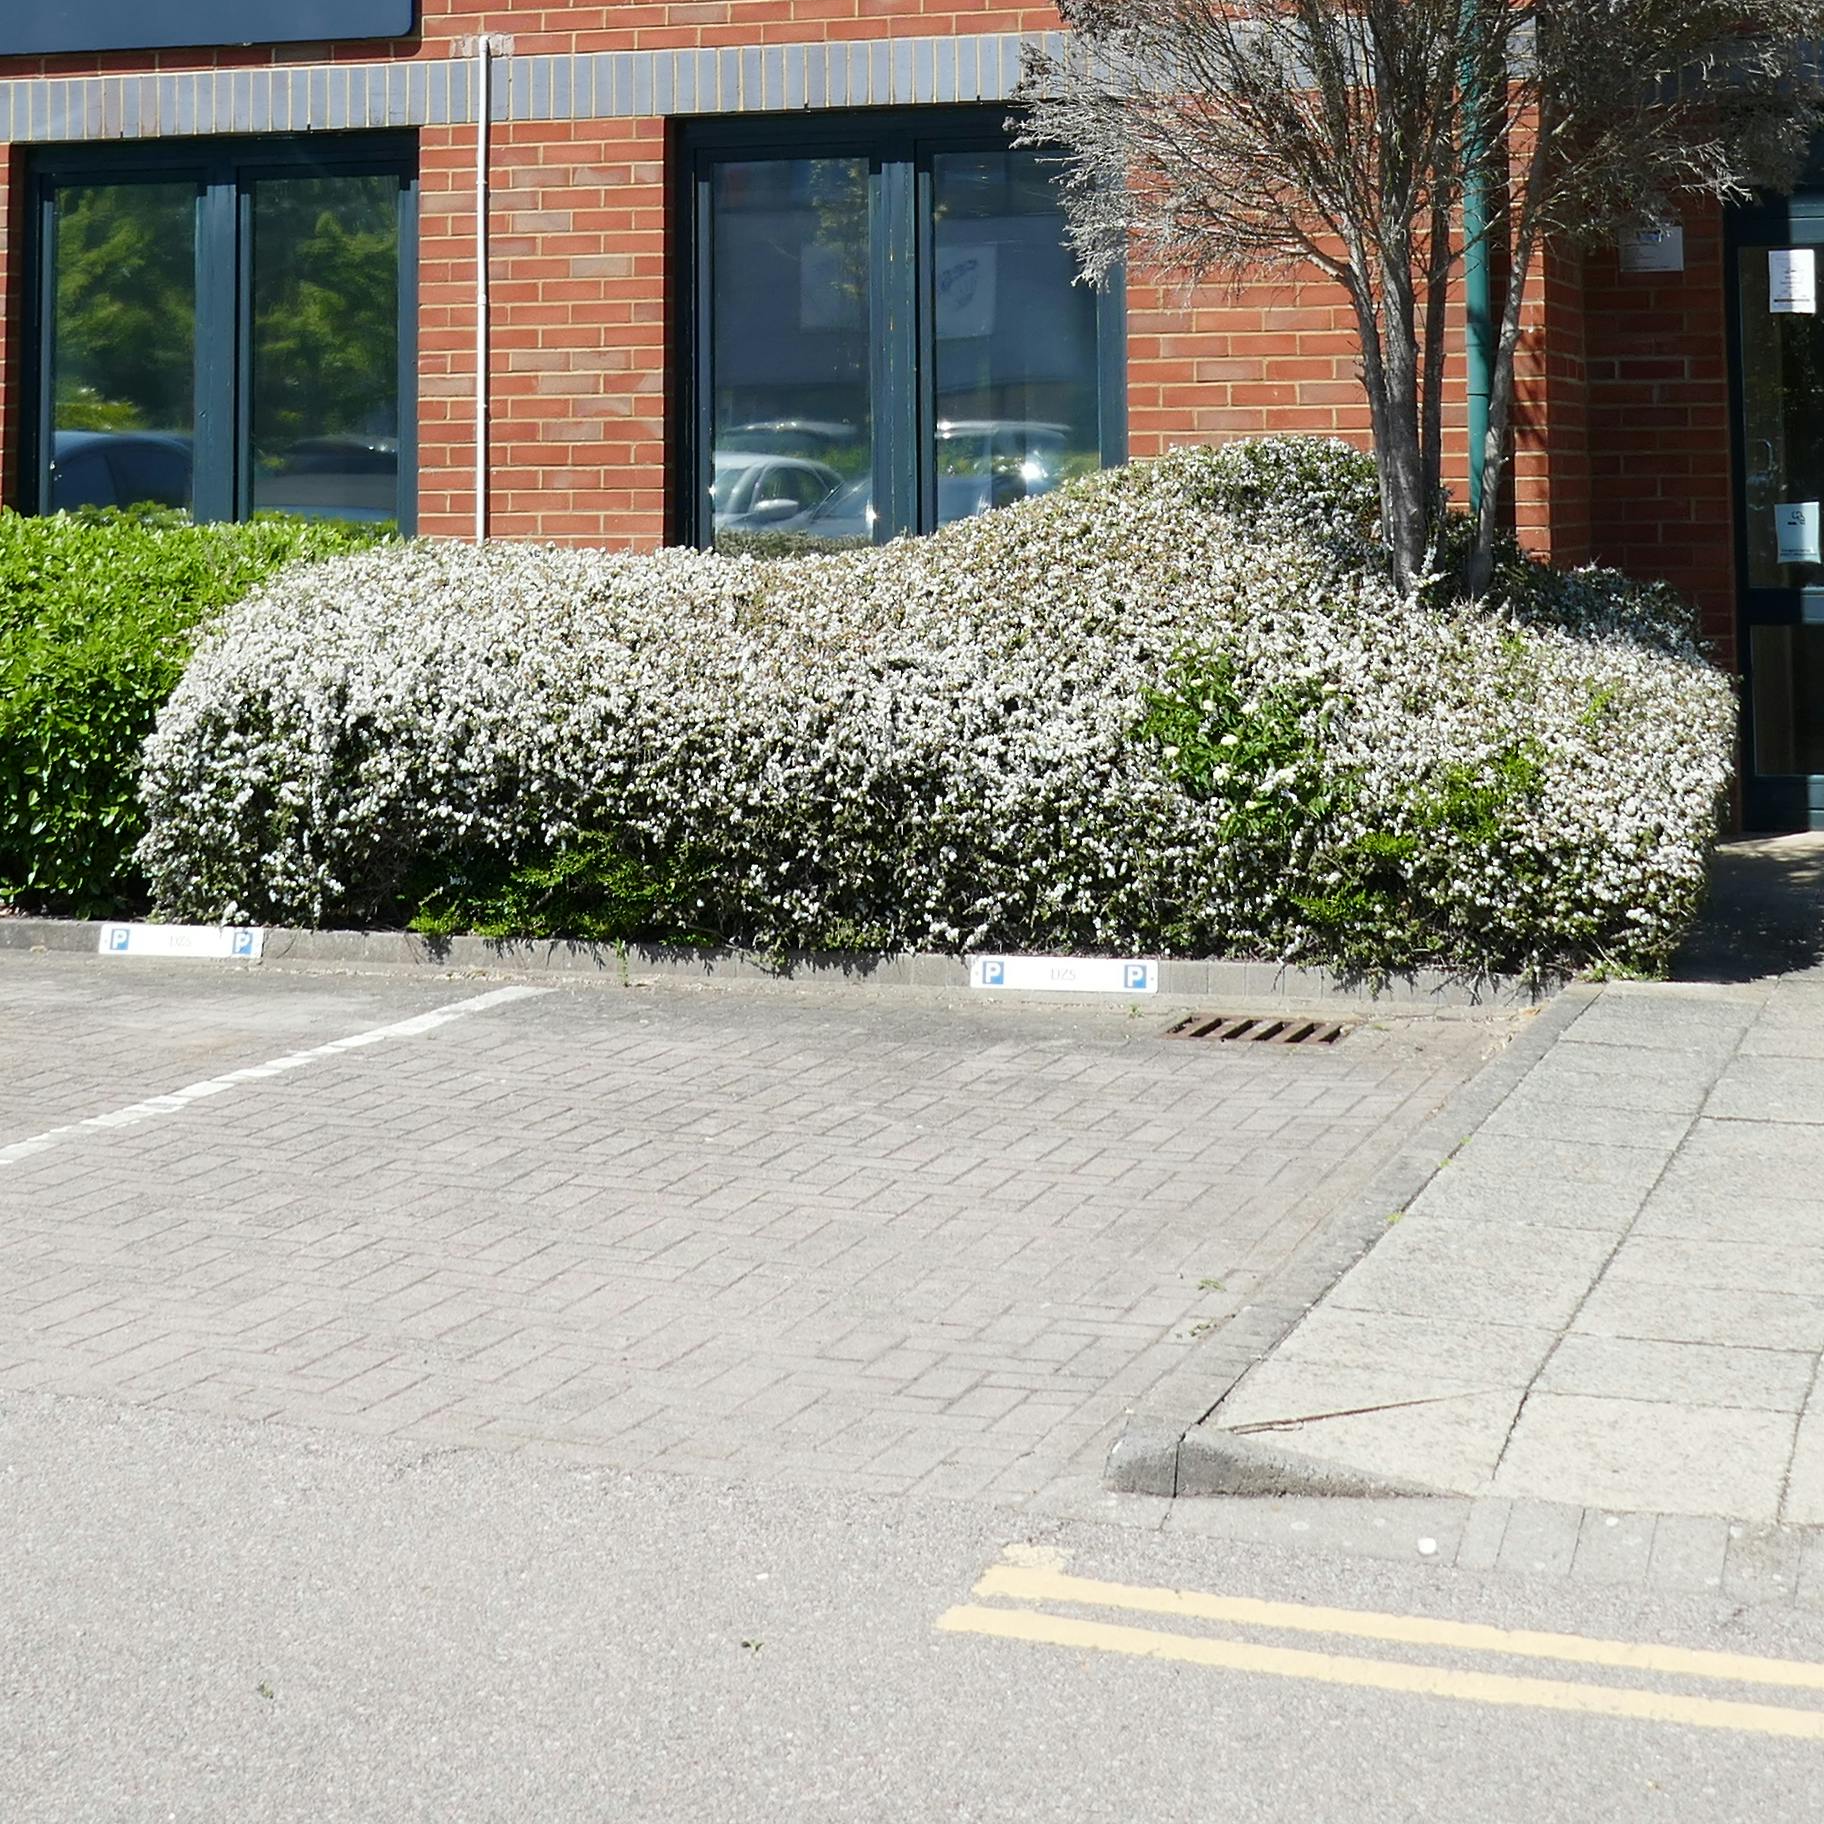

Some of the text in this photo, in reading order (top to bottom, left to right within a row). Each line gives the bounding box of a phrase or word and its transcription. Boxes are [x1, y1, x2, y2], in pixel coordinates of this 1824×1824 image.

[112, 929, 128, 950] P
[234, 932, 252, 953] P
[985, 962, 1002, 985] P
[1127, 965, 1144, 988] P
